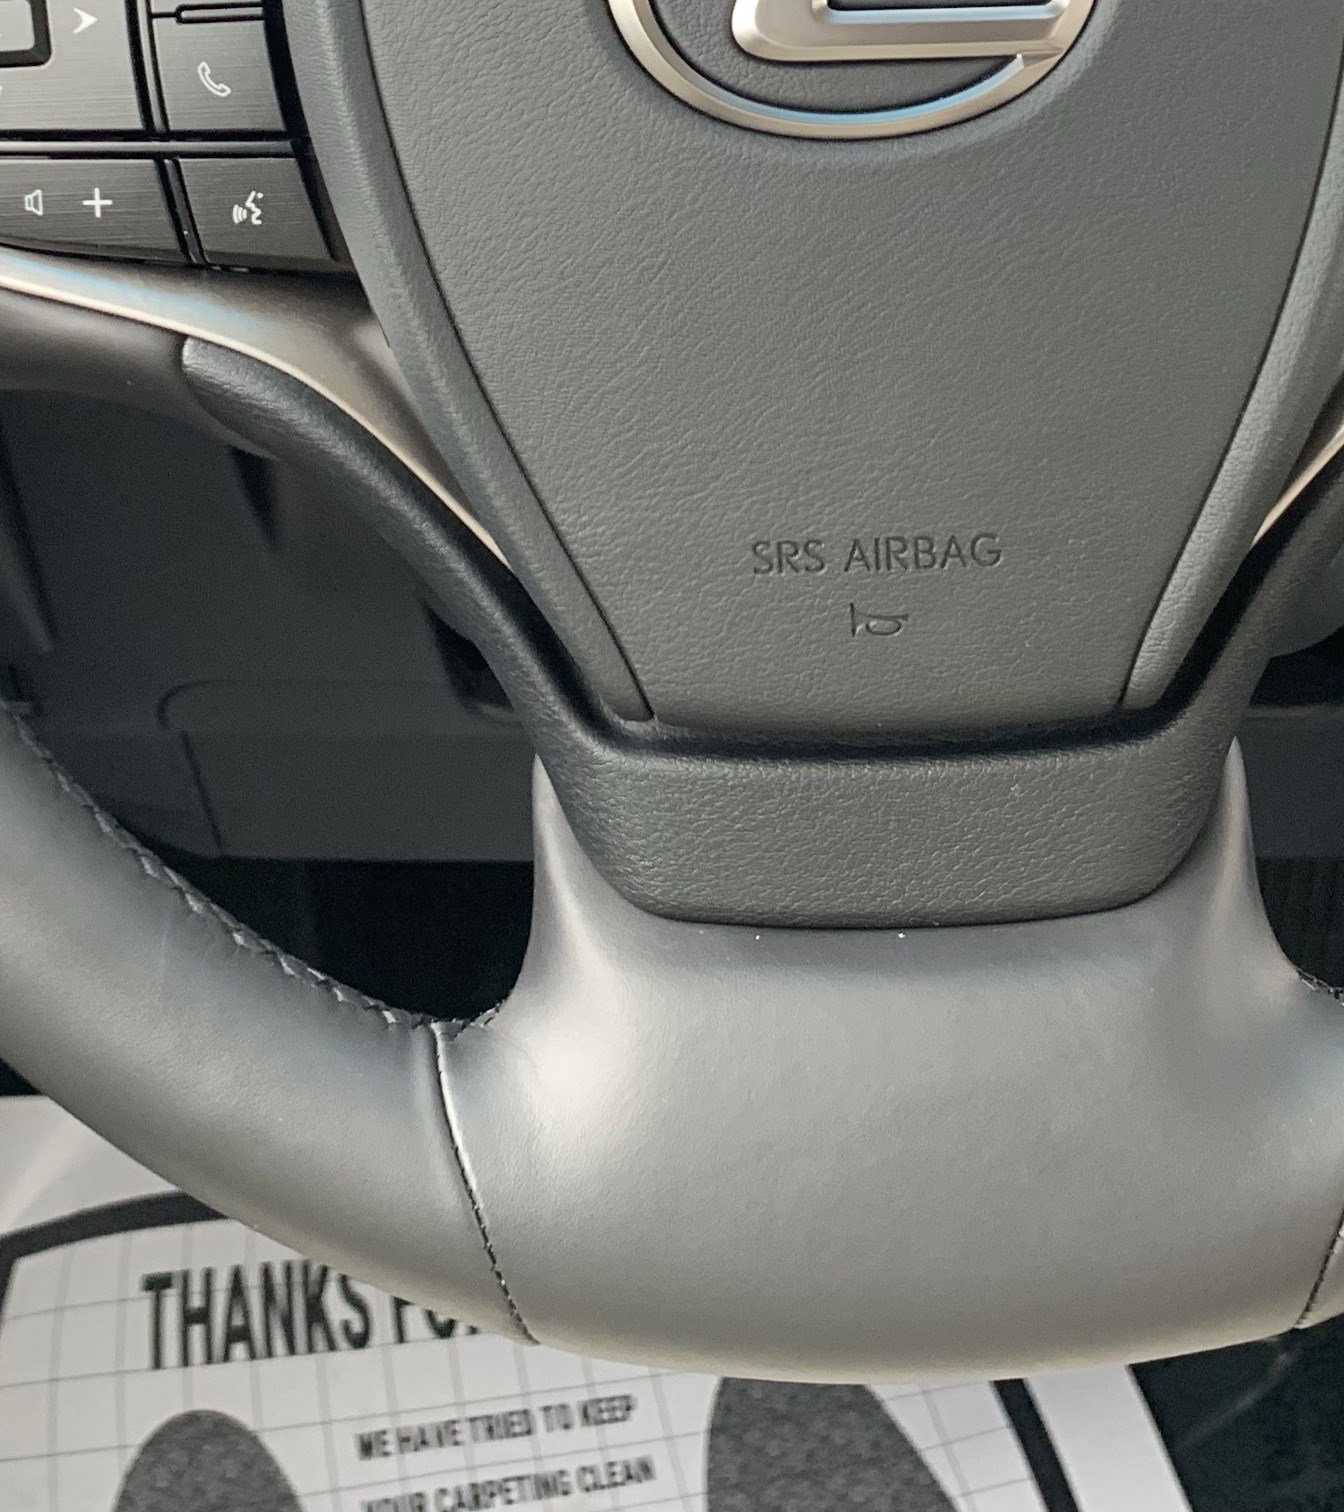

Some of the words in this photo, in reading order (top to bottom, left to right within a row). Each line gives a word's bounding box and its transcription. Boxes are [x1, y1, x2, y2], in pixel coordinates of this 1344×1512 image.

[751, 538, 827, 575] SRS
[844, 532, 1004, 573] AIRBAG
[140, 1259, 370, 1370] THANKS
[357, 1429, 392, 1460] WE
[395, 1419, 463, 1454] HAVE
[466, 1408, 533, 1443] TRIED
[539, 1402, 574, 1433] TO
[577, 1393, 636, 1426] KEEP
[433, 1469, 570, 1512] CARPETING
[575, 1455, 657, 1493] CLEAN
